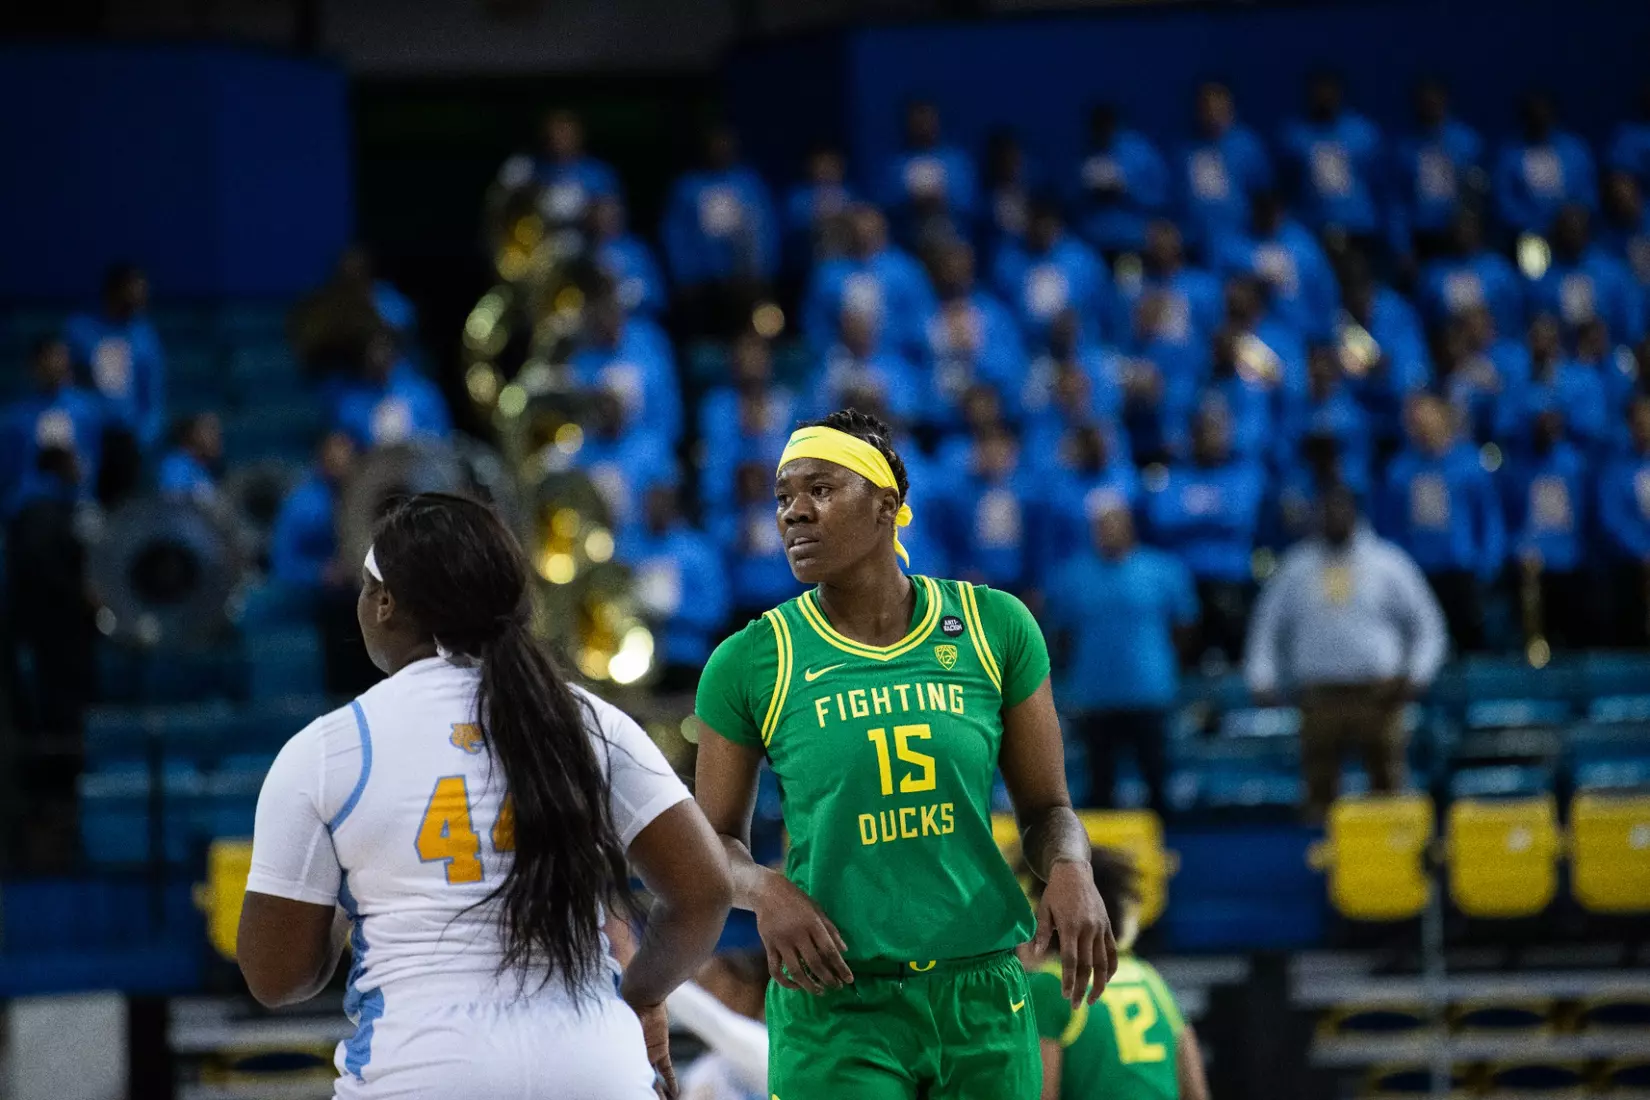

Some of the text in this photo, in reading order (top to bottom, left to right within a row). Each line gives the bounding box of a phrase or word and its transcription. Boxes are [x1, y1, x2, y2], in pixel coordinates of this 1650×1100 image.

[814, 682, 964, 728] FIGHTING
[867, 723, 936, 796] 15
[858, 802, 954, 846] DUCKS
